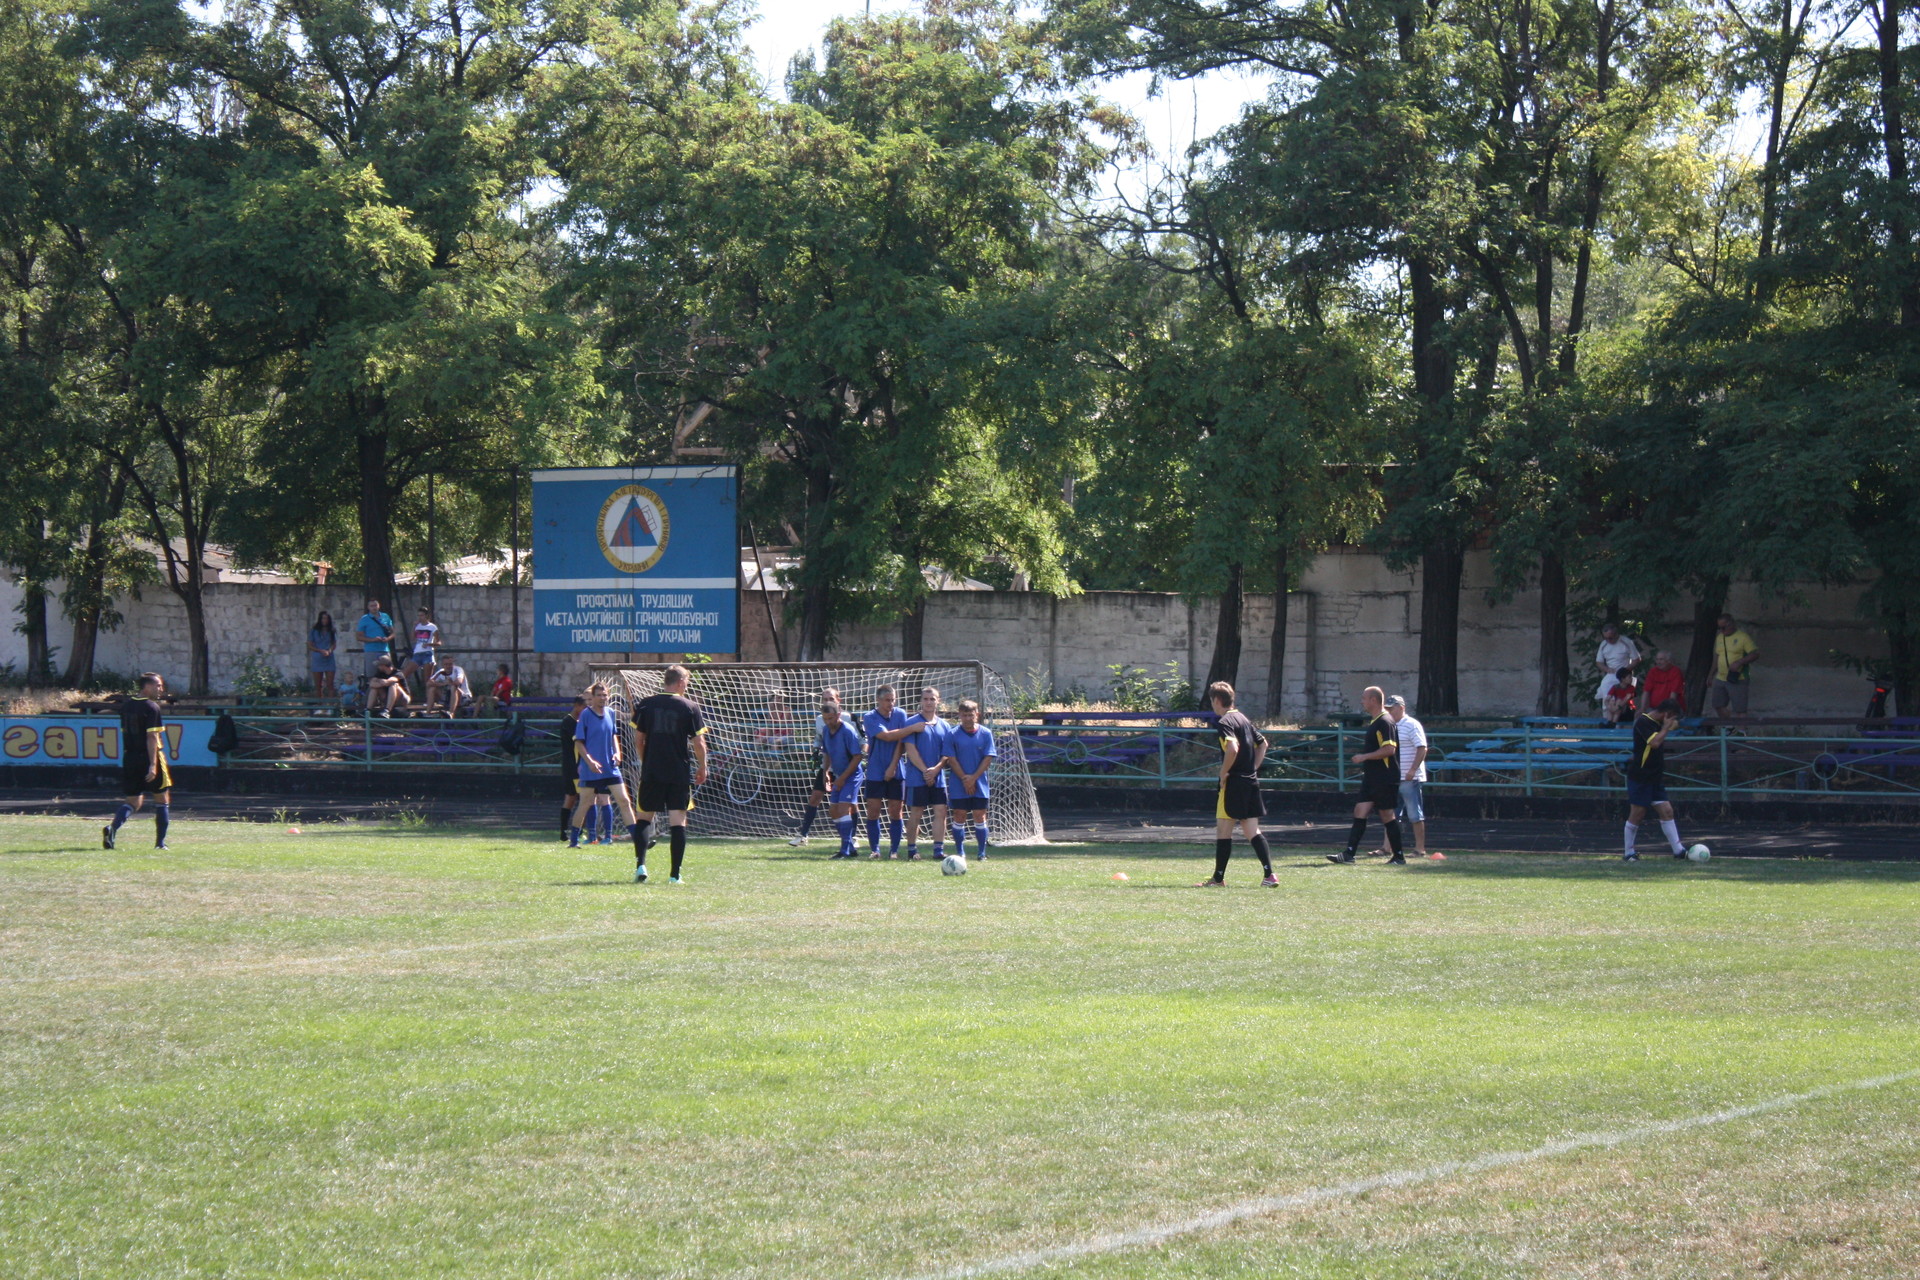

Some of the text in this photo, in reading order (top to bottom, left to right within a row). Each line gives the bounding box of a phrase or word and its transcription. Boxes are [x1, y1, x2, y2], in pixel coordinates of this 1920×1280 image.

[576, 594, 694, 609] ПРОФСПІЛКА ТРУДЯЩИХ
[545, 609, 625, 626] МЕТАЛУРГІЙНОЇ
[635, 611, 719, 626] ГІРНИЧОДОБУВНОЇ
[571, 629, 701, 643] ПРОМИСЛОВОСТІ УКРАЇНИ
